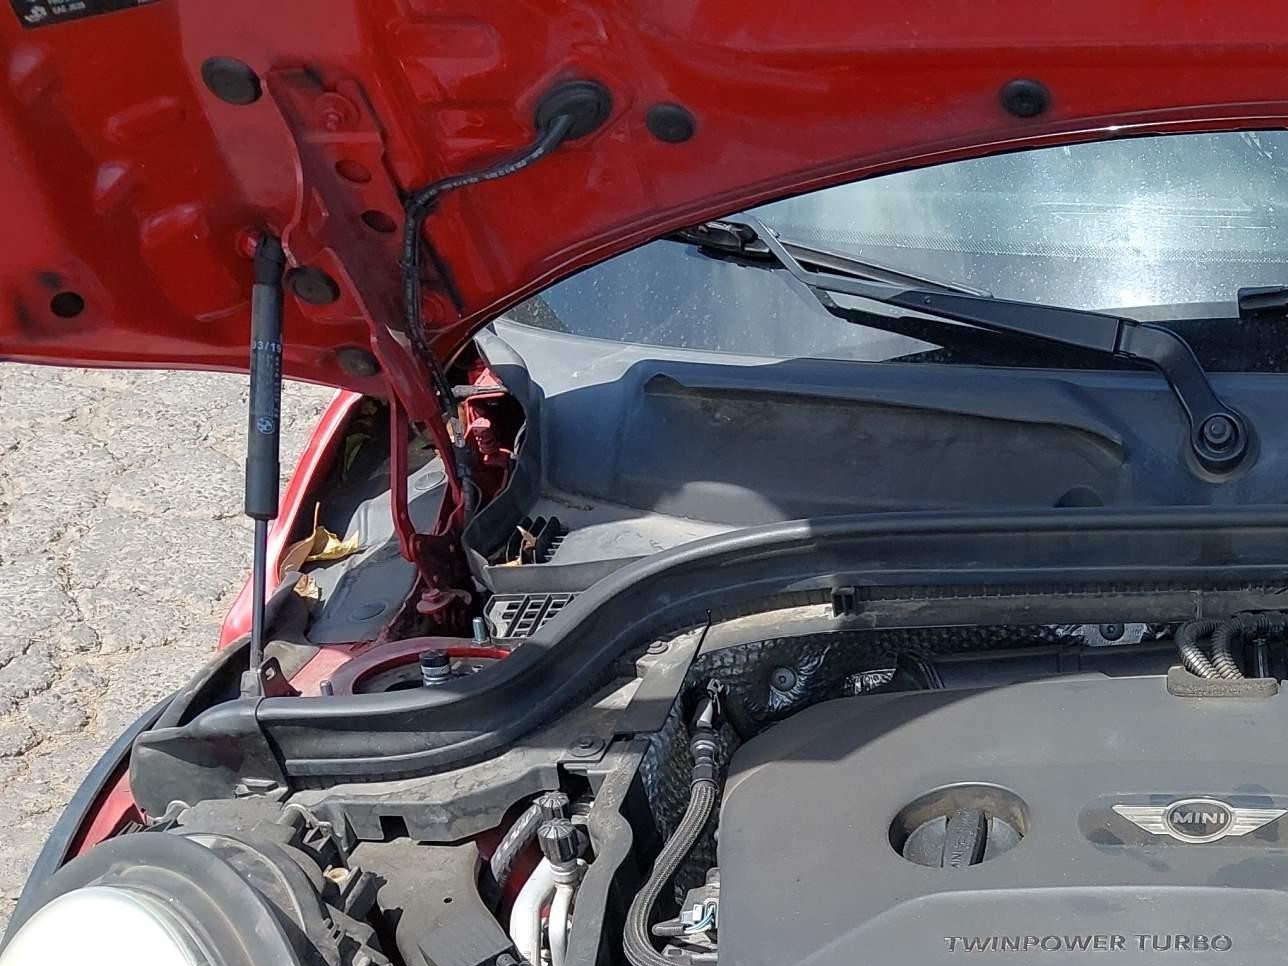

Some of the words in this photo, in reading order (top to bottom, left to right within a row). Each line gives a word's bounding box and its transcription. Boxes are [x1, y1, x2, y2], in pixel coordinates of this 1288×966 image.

[1173, 812, 1226, 825] MINI
[944, 934, 1126, 953] TWINPOWER
[1135, 933, 1233, 951] TURBO
